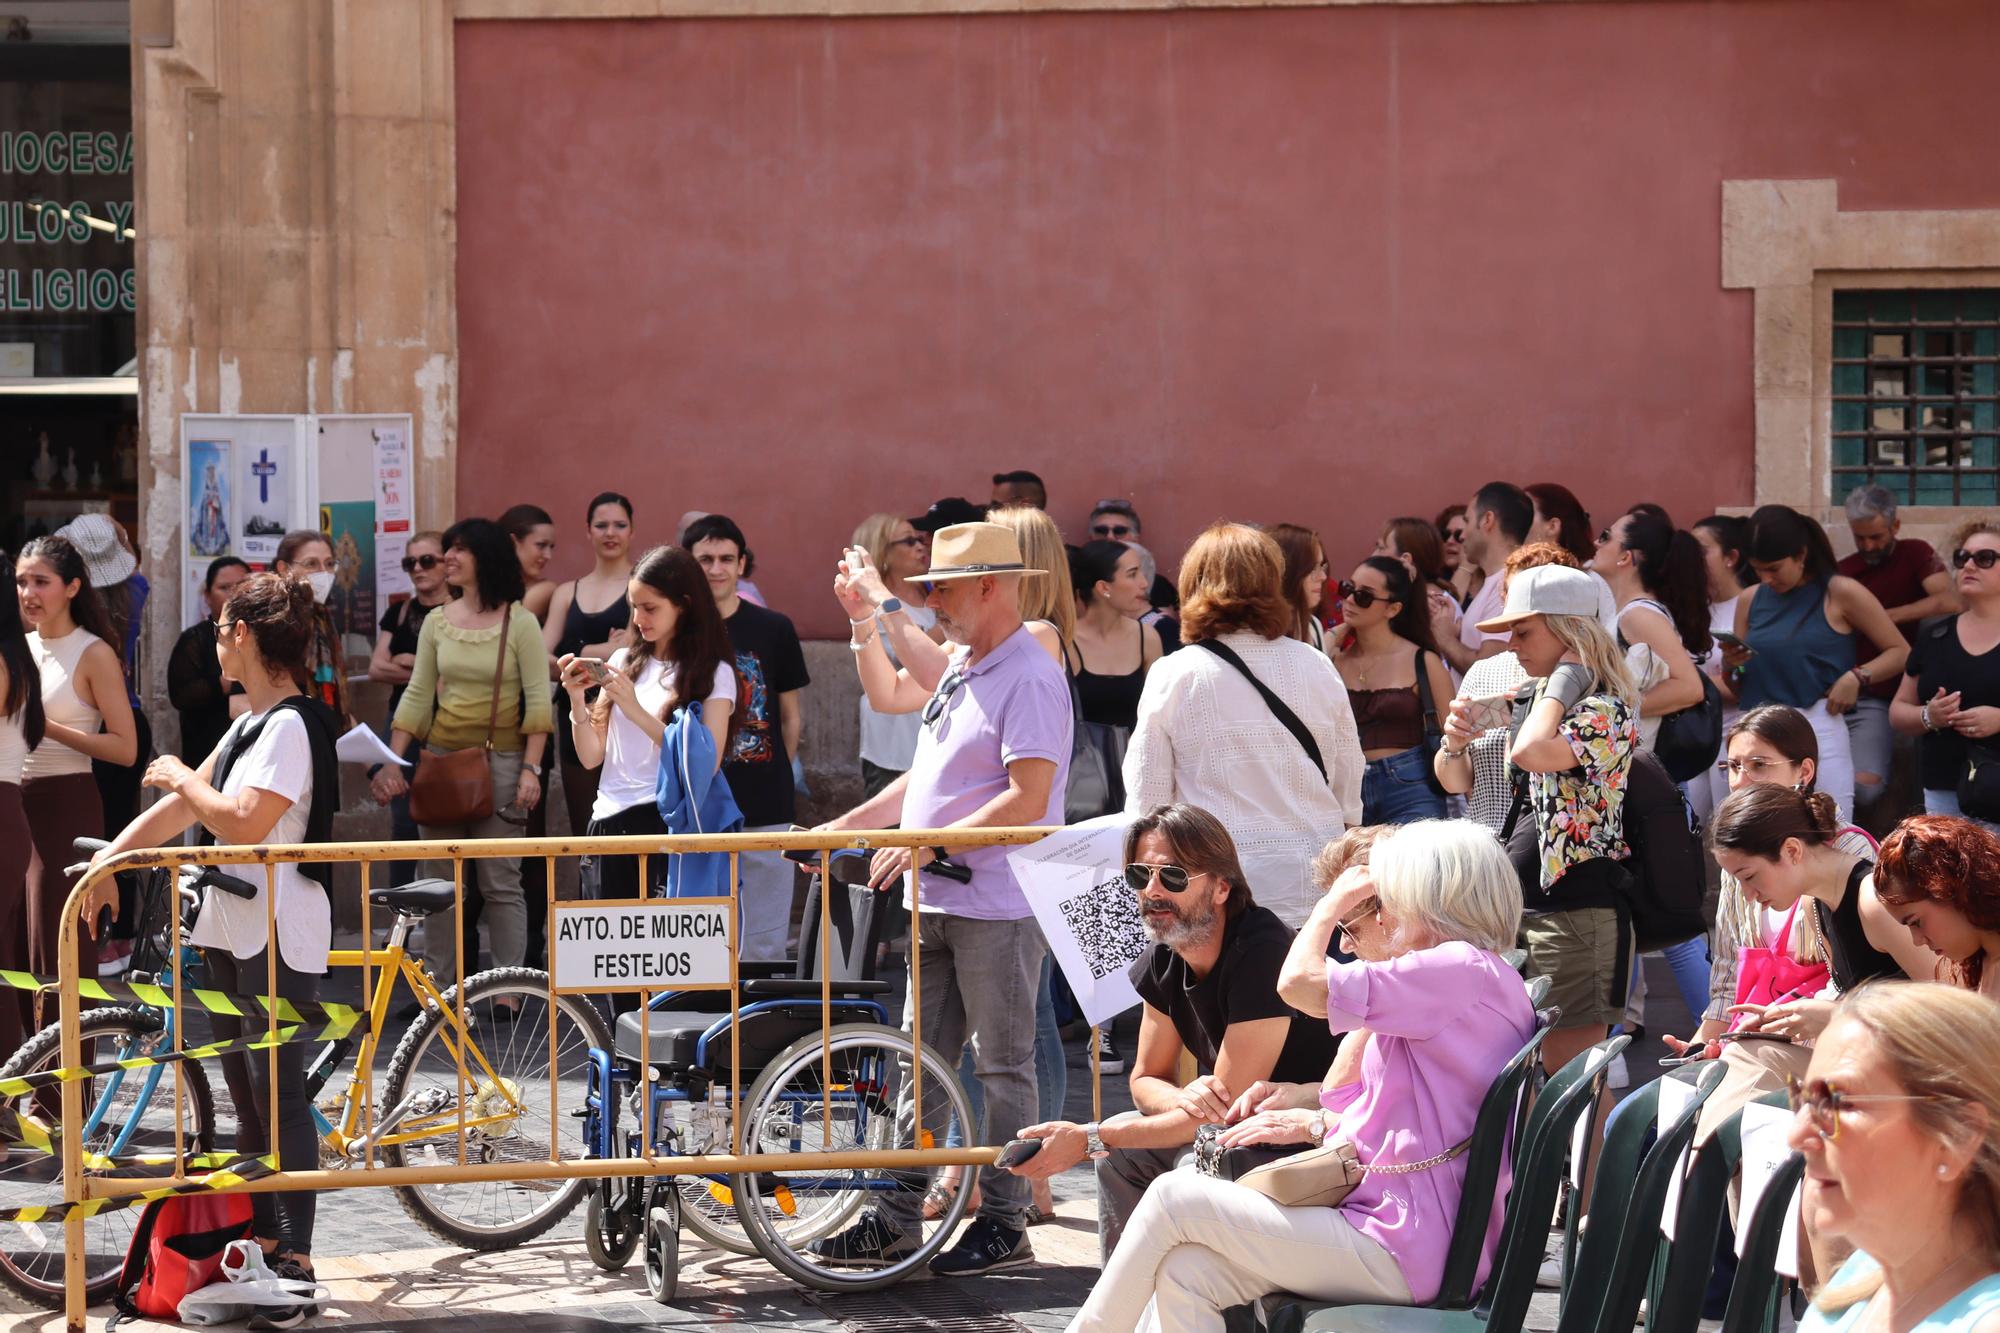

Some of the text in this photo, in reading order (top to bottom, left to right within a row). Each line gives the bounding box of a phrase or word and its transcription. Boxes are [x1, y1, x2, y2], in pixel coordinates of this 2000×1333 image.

[559, 913, 725, 941] AYTO. DE MURCIA
[594, 951, 691, 978] FESTEJOS
